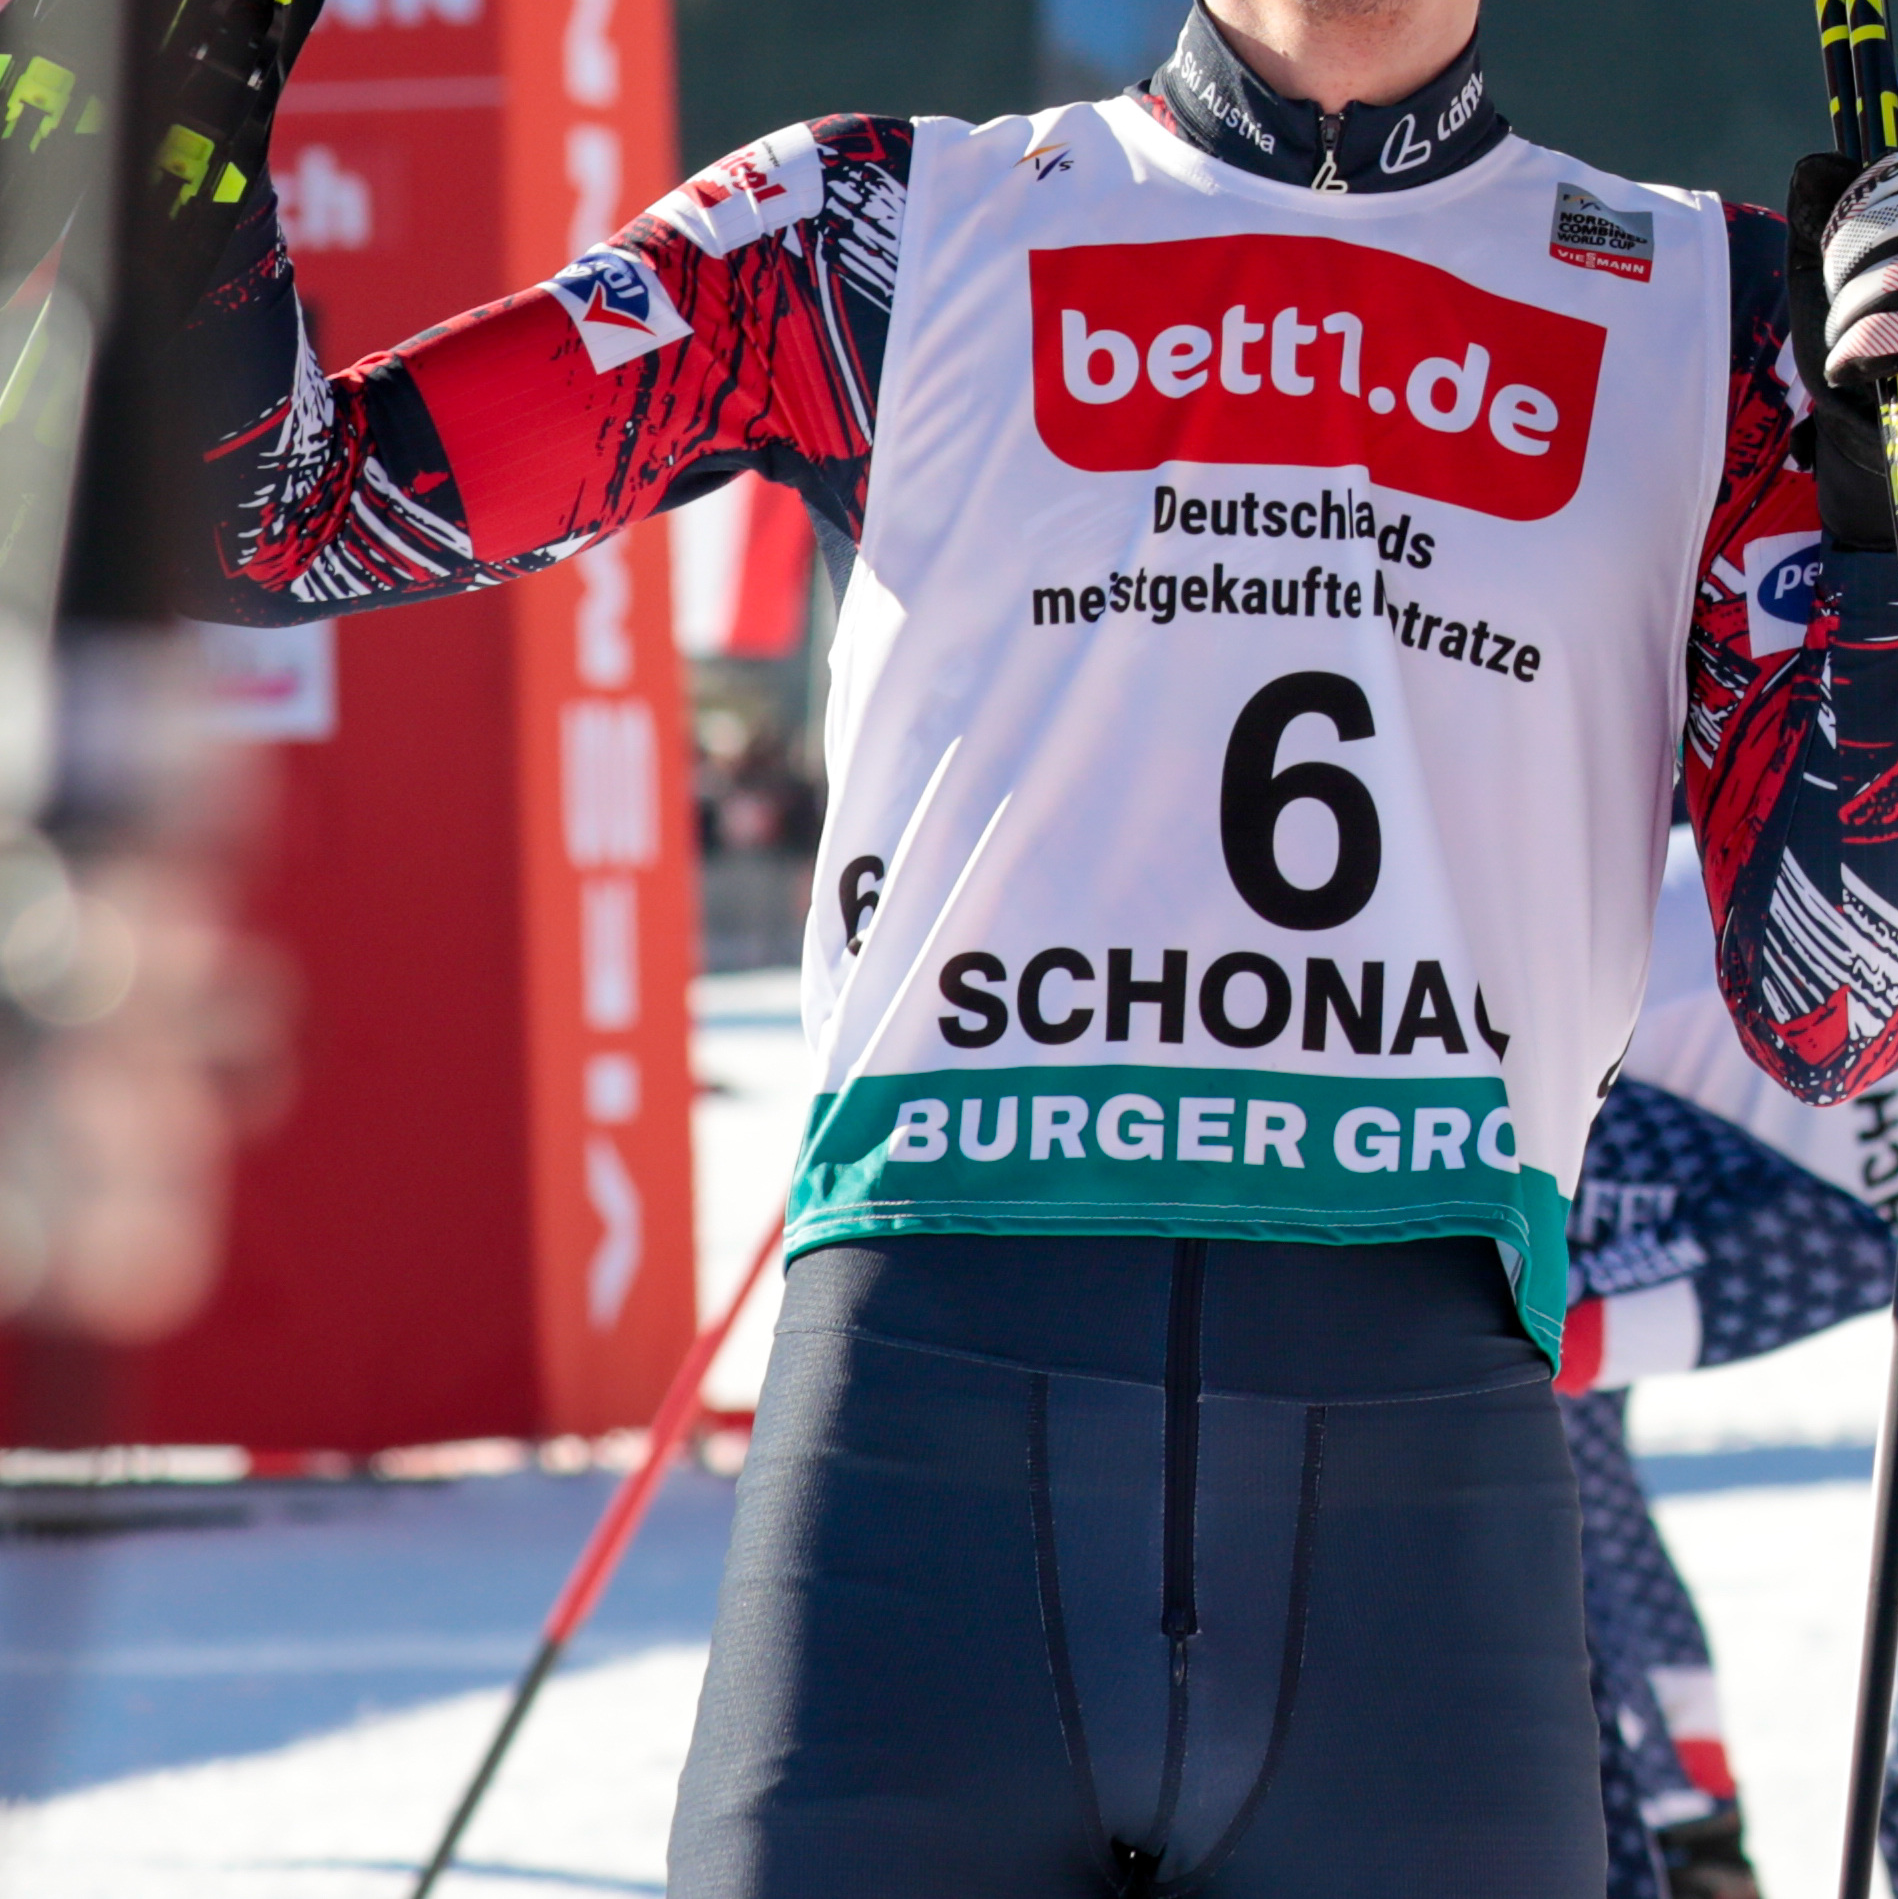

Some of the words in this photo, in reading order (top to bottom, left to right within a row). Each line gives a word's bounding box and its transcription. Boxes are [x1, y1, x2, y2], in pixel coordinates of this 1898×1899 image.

[1181, 51, 1203, 95] Ski
[1200, 76, 1277, 156] Austria
[1557, 232, 1606, 246] WORLD
[1609, 238, 1636, 251] CUP
[1060, 303, 1560, 458] bett1.de
[1153, 485, 1437, 570] Deutschlads
[1220, 671, 1382, 930] 6
[938, 947, 1511, 1063] SCHONA
[891, 1094, 1307, 1170] BURGER
[1332, 1105, 1521, 1175] GRO
